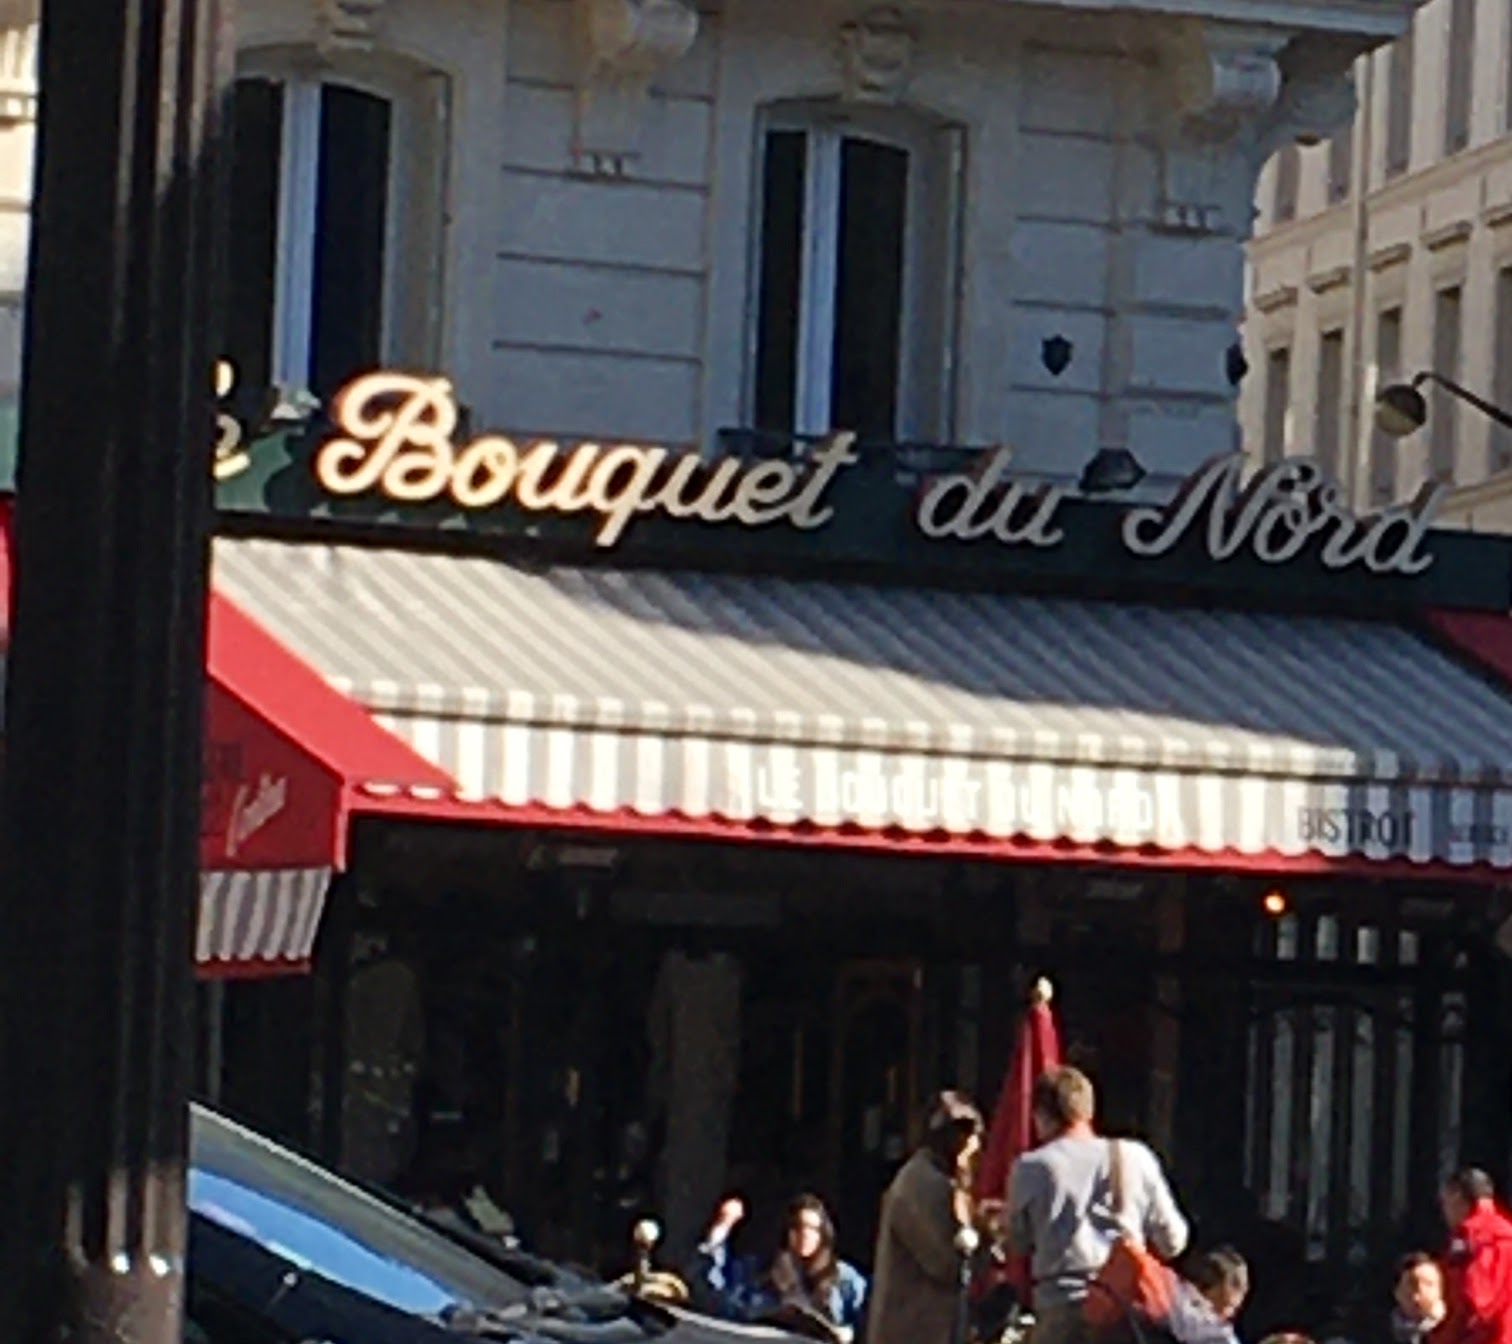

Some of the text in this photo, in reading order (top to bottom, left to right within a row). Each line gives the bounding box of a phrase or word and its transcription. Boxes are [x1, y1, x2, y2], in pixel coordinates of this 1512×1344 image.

[316, 373, 857, 547] Bouquet
[917, 448, 1063, 546] du
[1122, 457, 1449, 573] Nord
